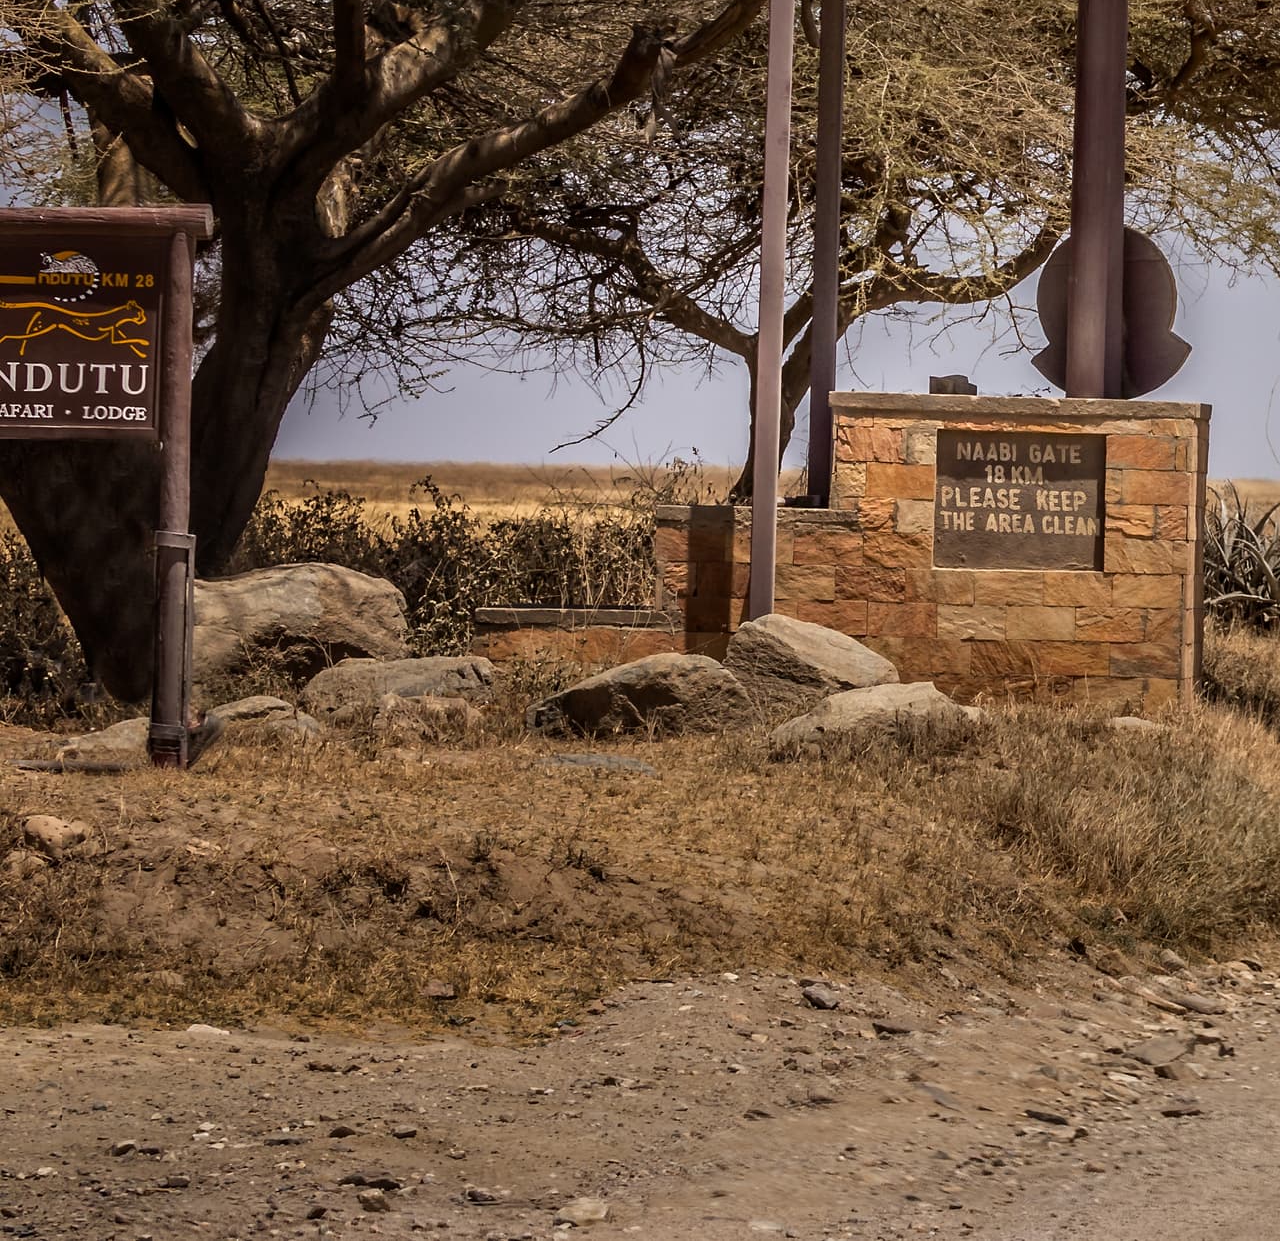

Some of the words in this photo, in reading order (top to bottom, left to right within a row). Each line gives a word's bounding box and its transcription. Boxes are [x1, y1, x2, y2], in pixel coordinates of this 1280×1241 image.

[102, 273, 129, 288] KM
[135, 274, 155, 288] 28
[82, 406, 148, 421] LODGE
[956, 441, 1017, 462] NAABI
[1028, 444, 1082, 464] GATE
[984, 464, 1005, 484] 18
[940, 486, 1021, 510] PLEASE
[1035, 489, 1088, 512] KEEP
[939, 510, 976, 531] THE
[984, 513, 1036, 534] AREA
[1041, 515, 1097, 536] CLEAN
